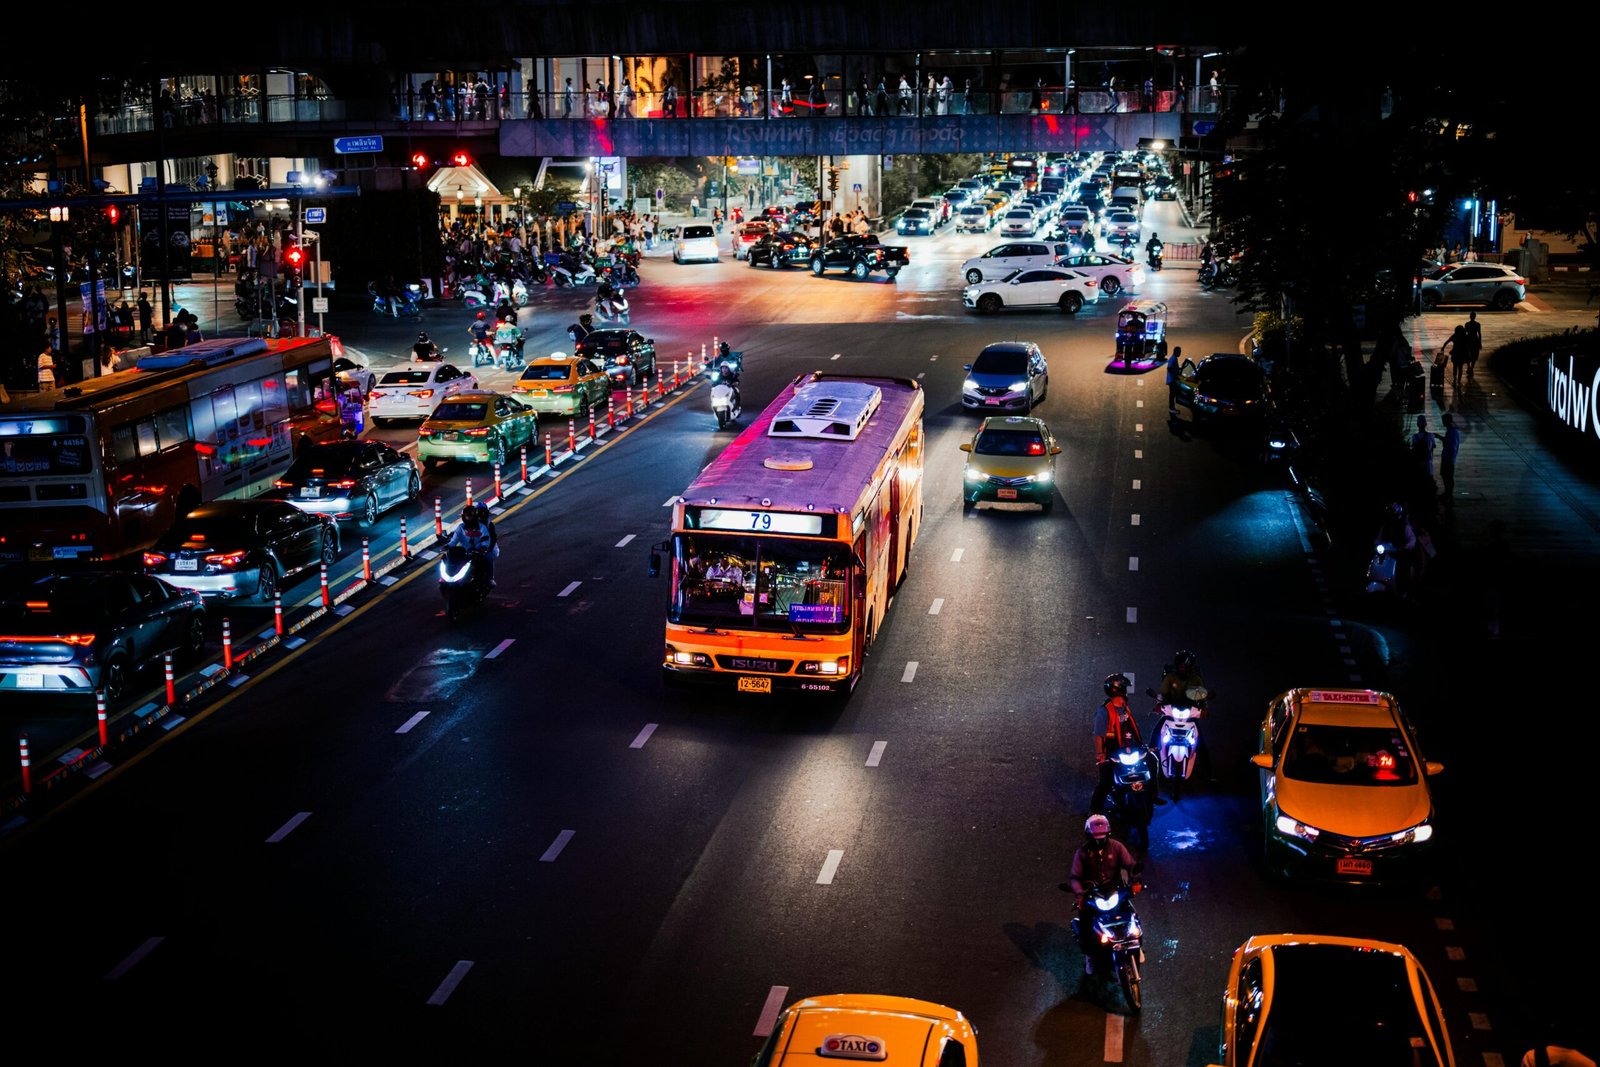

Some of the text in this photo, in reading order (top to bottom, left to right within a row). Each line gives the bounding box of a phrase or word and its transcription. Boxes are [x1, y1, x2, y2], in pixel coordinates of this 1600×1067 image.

[750, 513, 772, 530] 79
[732, 658, 777, 671] ISUZU
[740, 679, 769, 689] 12-5647
[1322, 692, 1370, 703] TAXI-METER
[840, 1040, 867, 1051] TAXI
